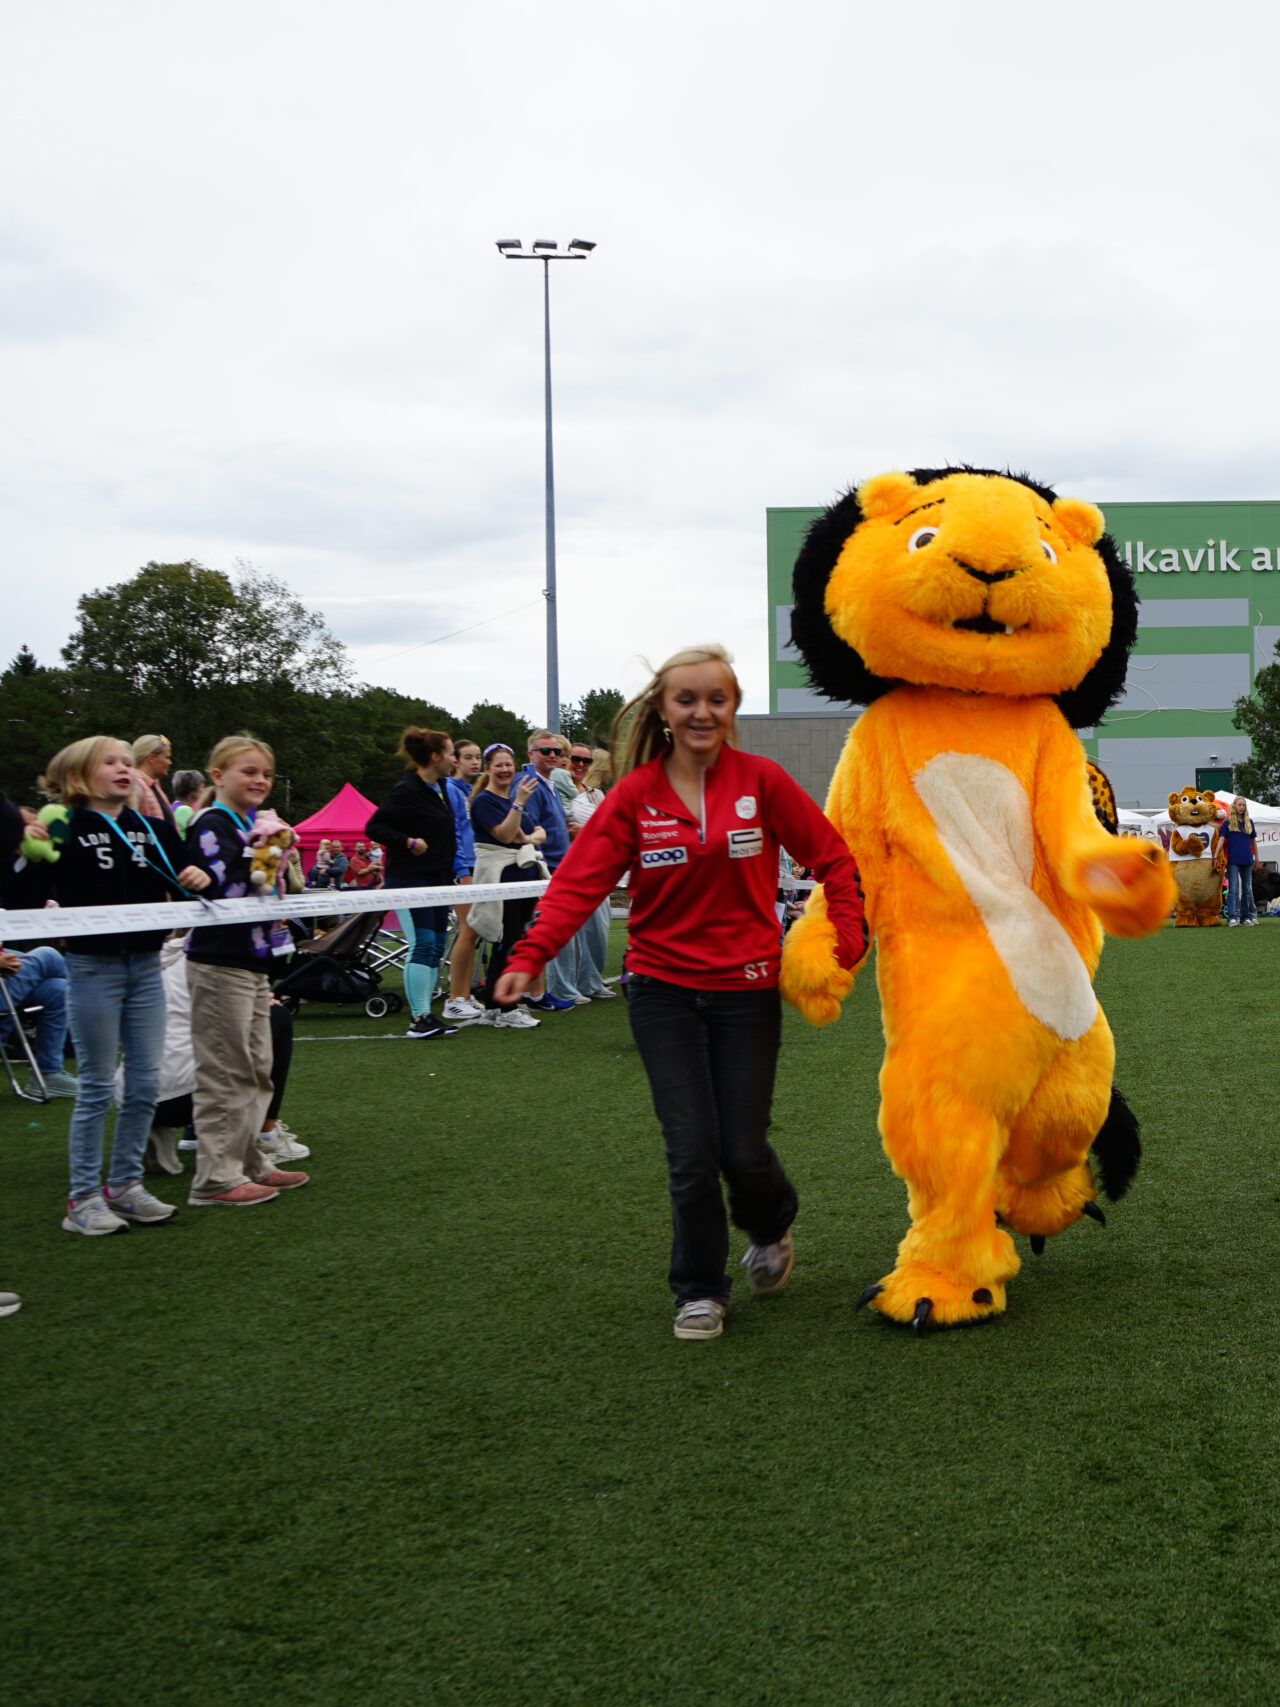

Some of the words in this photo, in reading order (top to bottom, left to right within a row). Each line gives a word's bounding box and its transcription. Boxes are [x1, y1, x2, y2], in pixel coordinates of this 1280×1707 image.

[1117, 539, 1241, 573] lkavik
[642, 848, 684, 864] coop
[744, 961, 769, 981] ST
